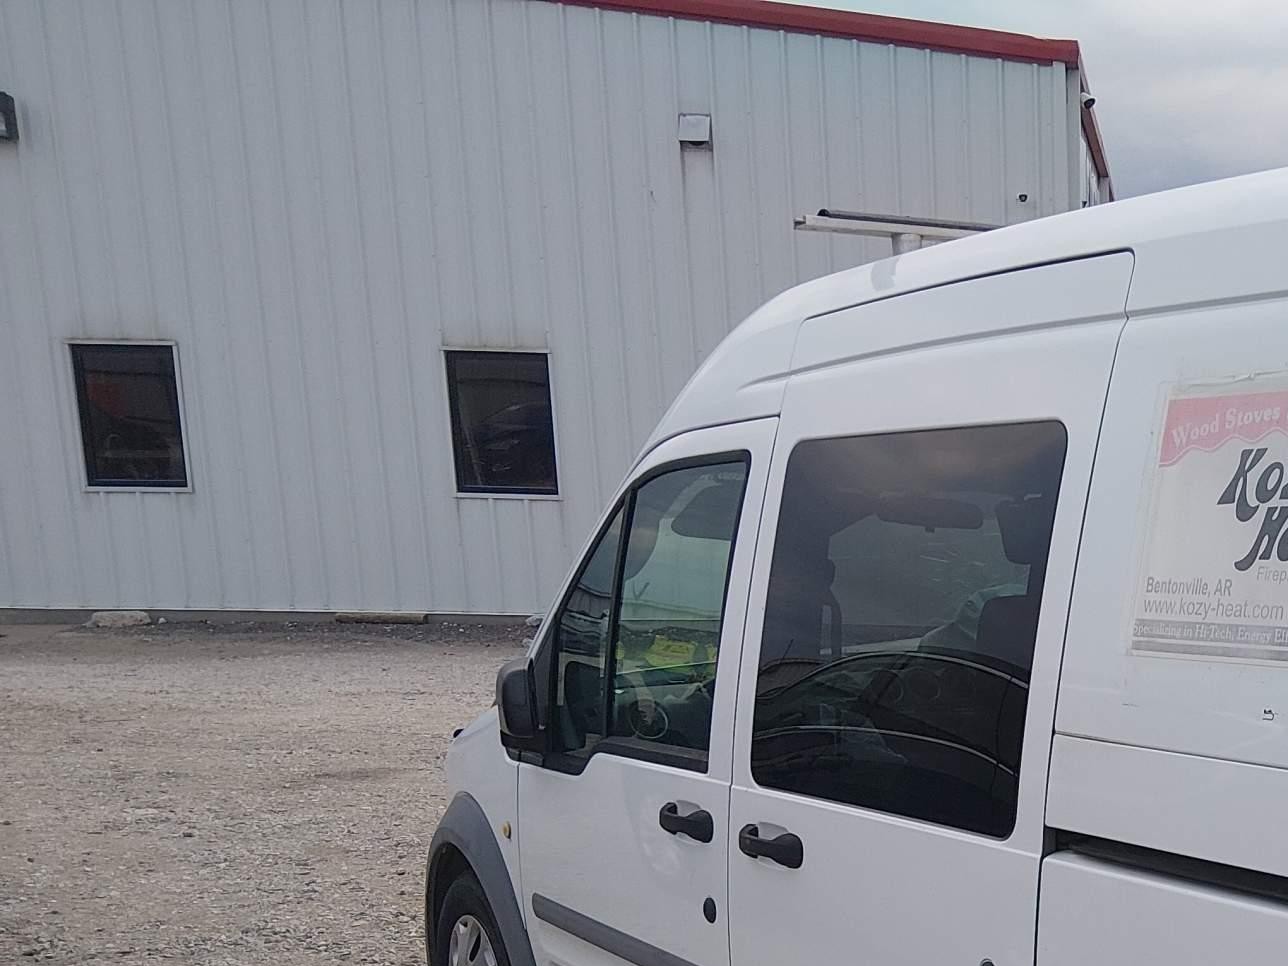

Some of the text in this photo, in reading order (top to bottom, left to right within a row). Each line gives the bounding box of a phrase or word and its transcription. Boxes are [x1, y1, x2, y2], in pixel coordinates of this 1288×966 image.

[1171, 412, 1219, 448] Wood
[1224, 405, 1280, 430] Stoves
[1145, 577, 1233, 598] Bentonville, AR
[1143, 597, 1284, 621] www.kozy-heat.com
[1237, 626, 1272, 644] Energy
